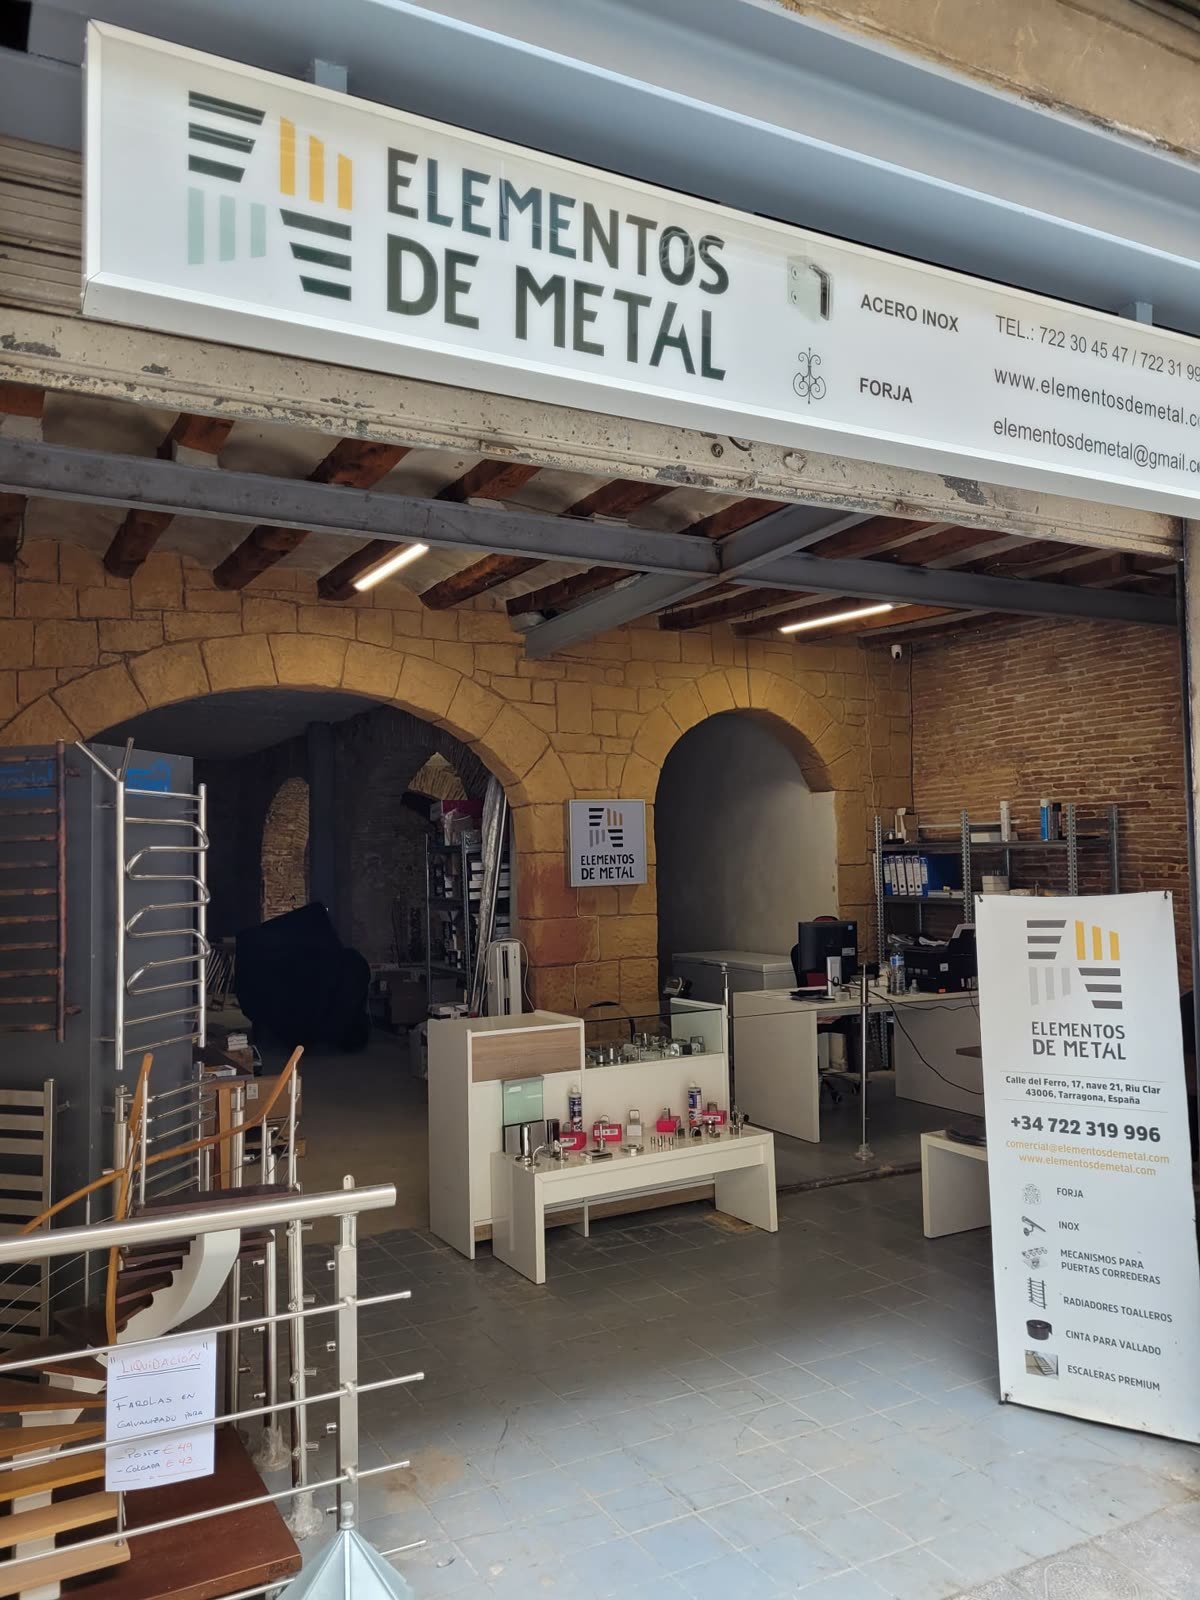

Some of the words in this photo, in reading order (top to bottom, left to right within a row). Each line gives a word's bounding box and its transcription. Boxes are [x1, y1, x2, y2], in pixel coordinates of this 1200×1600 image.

[387, 146, 730, 295] ELEMENTOS
[387, 233, 480, 329] DE
[515, 265, 727, 381] METAL
[860, 294, 917, 322] ACERO
[922, 308, 959, 333] INOX
[996, 314, 1034, 341] TEL.:
[1040, 326, 1065, 348] 722
[1070, 334, 1086, 354] 30
[1091, 340, 1108, 358] 45
[1112, 346, 1128, 363] 47
[1140, 352, 1164, 373] 722
[1168, 358, 1182, 377] 31
[859, 377, 913, 404] FORJA
[994, 368, 1200, 428] www.elementosdemetal.c
[580, 854, 634, 866] ELEMENTOS
[581, 868, 595, 880] DE
[600, 866, 634, 879] METAL
[1032, 1021, 1126, 1039] ELEMENTOS
[1032, 1039, 1056, 1056] DE
[1064, 1040, 1126, 1060] METAL
[1006, 1076, 1026, 1084] Calle
[1028, 1077, 1041, 1085] del
[1044, 1078, 1070, 1088] Ferro,
[1072, 1080, 1084, 1089] 17,
[1086, 1082, 1107, 1090] nave
[1110, 1083, 1123, 1092] 21,
[1125, 1084, 1140, 1093] Riu
[1142, 1086, 1161, 1094] Clar
[1025, 1089, 1056, 1099] 43006,
[1058, 1090, 1106, 1102] Tarragona,
[1108, 1094, 1140, 1105] España
[1011, 1115, 1043, 1131] +34
[1048, 1118, 1081, 1135] 722
[1086, 1121, 1118, 1138] 319
[1124, 1124, 1161, 1142] 996
[1006, 1140, 1170, 1164] comercial@elementosdemetal.com
[1019, 1154, 1156, 1176] www.elementosdemetal.com
[1056, 1187, 1083, 1198] FORJA
[1058, 1221, 1080, 1231] INOX
[1060, 1249, 1117, 1265] MECANISMOS
[1119, 1257, 1144, 1269] PARA
[1061, 1262, 1100, 1275] PUERTAS
[1102, 1267, 1161, 1285] CORREDERAS
[1063, 1296, 1119, 1314] RADIADORES
[1121, 1306, 1173, 1323] TOALLEROS
[1065, 1330, 1091, 1342] CINTA
[1093, 1335, 1117, 1348] PARA
[1120, 1340, 1161, 1356] VALLADO
[1067, 1365, 1116, 1383] ESCALERAS
[1118, 1375, 1160, 1391] PREMIUM
[112, 1396, 172, 1410] FAROLAS
